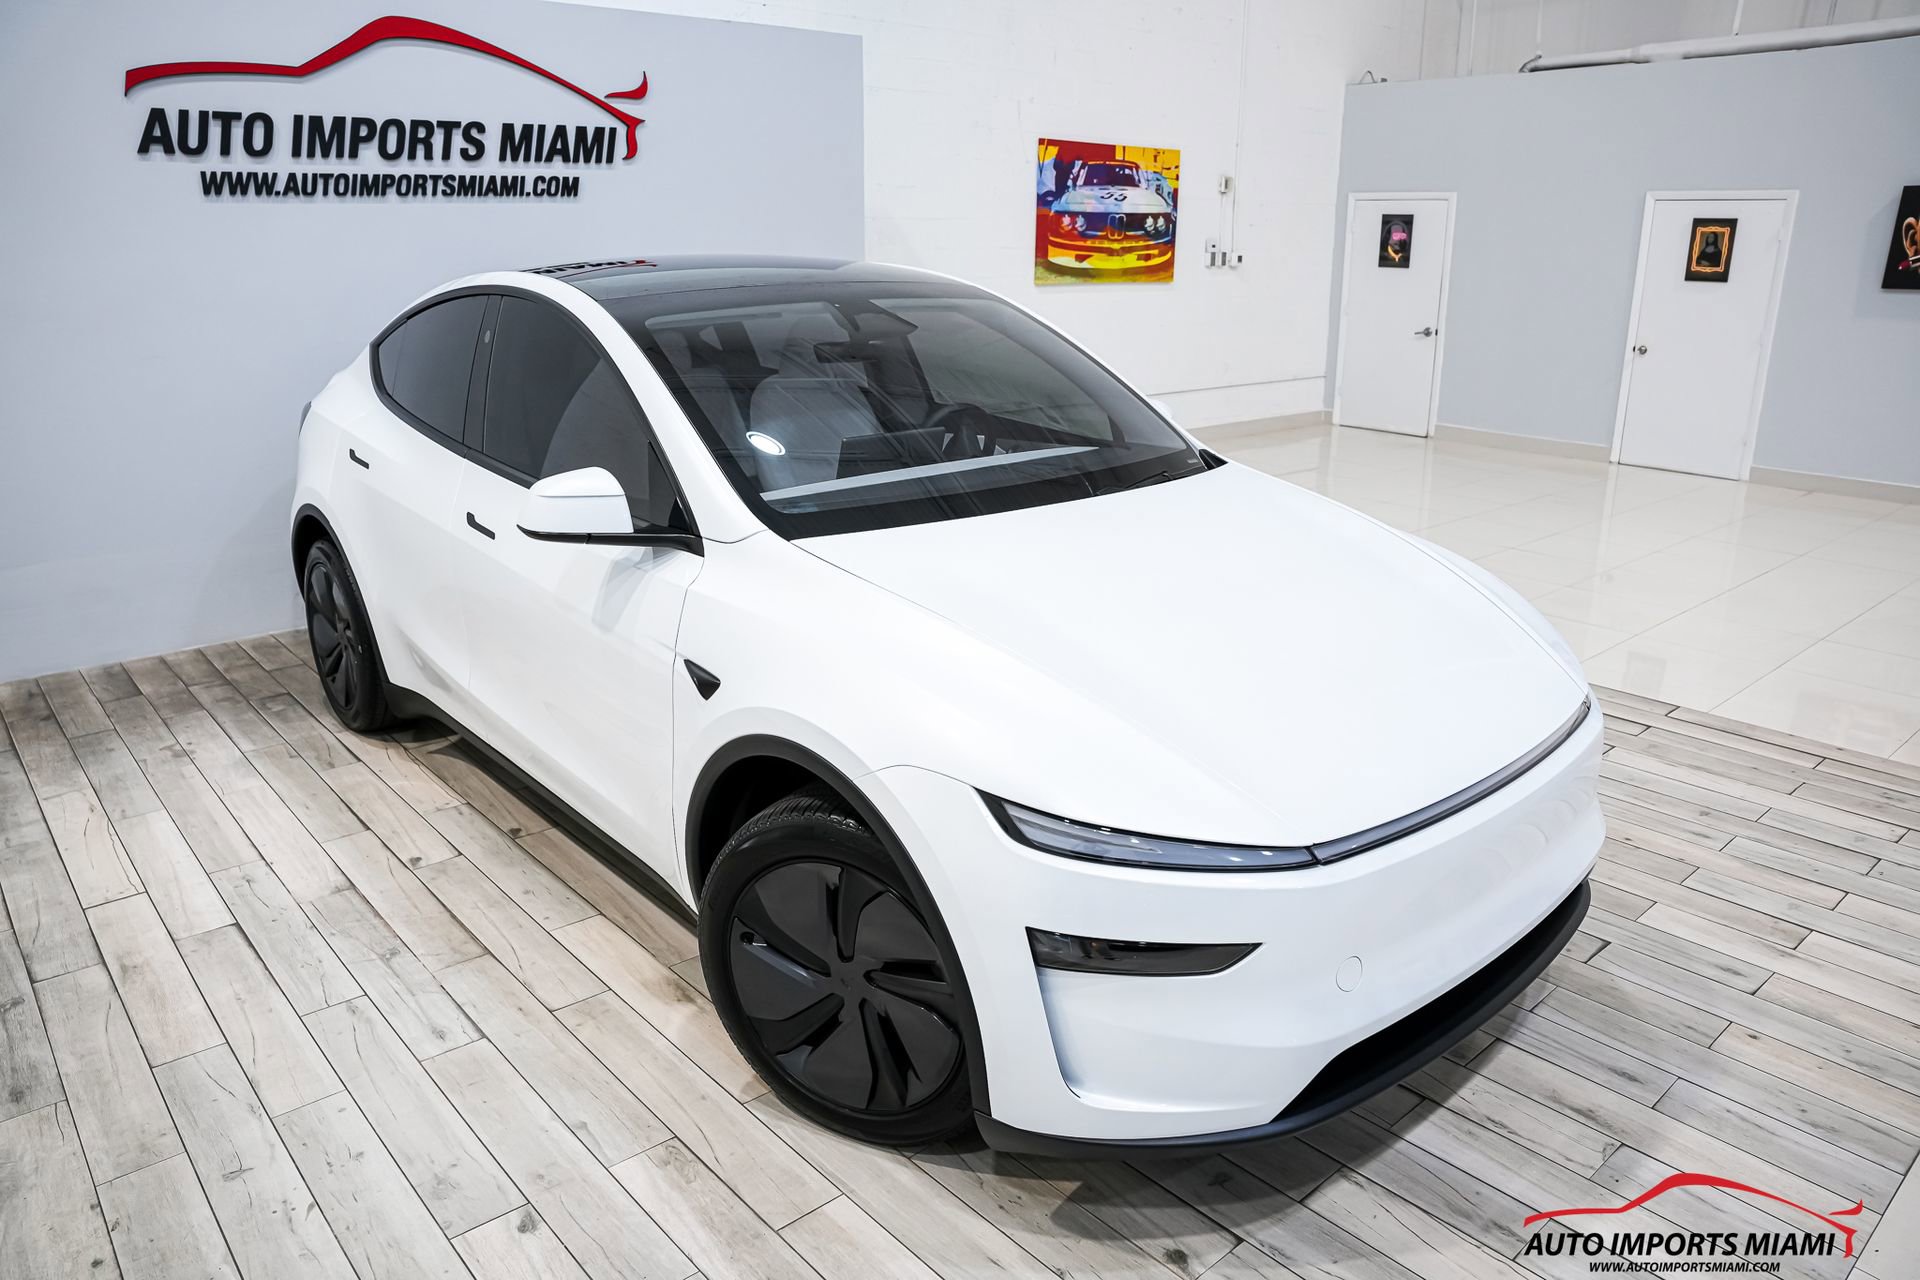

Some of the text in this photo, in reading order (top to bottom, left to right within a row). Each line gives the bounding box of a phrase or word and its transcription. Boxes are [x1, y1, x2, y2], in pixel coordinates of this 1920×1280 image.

[137, 107, 618, 165] AUTO IMPORTS MIAMI
[200, 170, 580, 198] WWW.AUTOIMPORTSMIAMI.COM
[1099, 191, 1128, 203] 55
